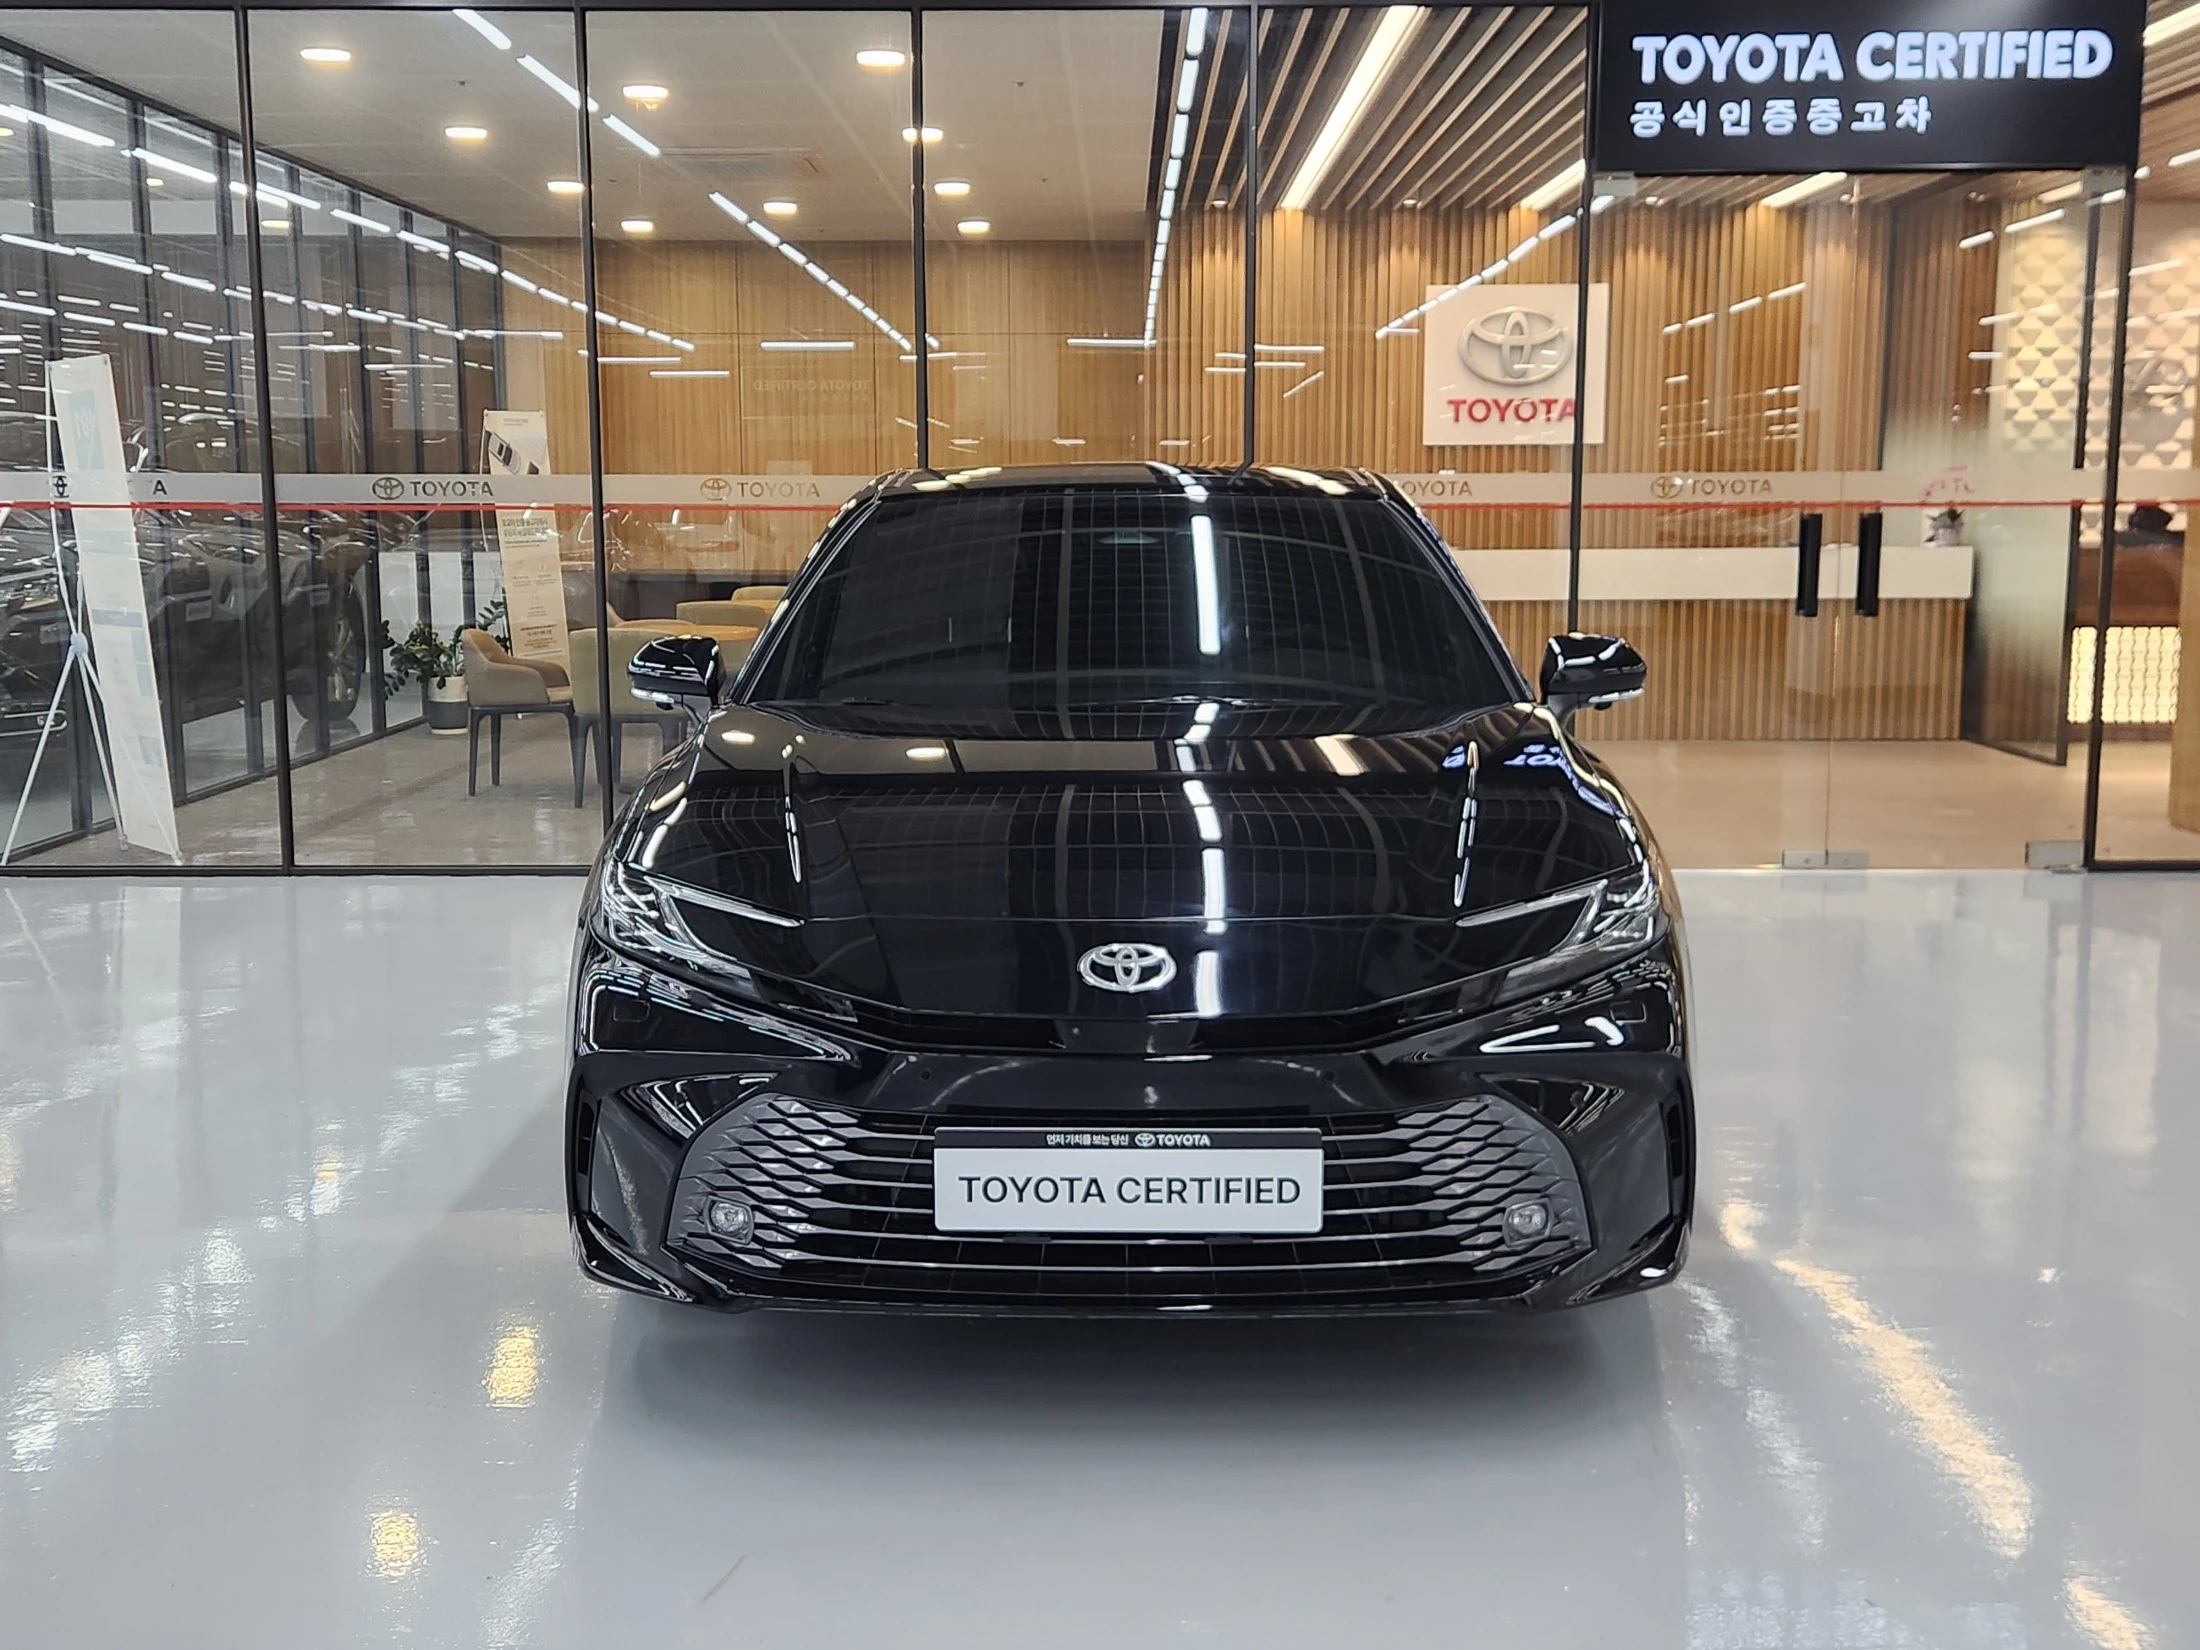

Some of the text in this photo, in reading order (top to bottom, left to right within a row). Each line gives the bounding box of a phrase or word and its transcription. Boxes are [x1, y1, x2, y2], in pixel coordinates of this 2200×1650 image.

[1632, 29, 2113, 85] TOYOTA CERTIFIED
[1447, 398, 1575, 424] TOYOTA
[409, 481, 494, 497] TOYOTA
[737, 481, 821, 498] TOYOTA
[1402, 480, 1473, 497] OYOTA
[1689, 479, 1773, 495] TOYOTA
[1156, 1134, 1211, 1147] TOYOTA
[958, 1176, 1301, 1204] TOYOTA CERTIFIED
